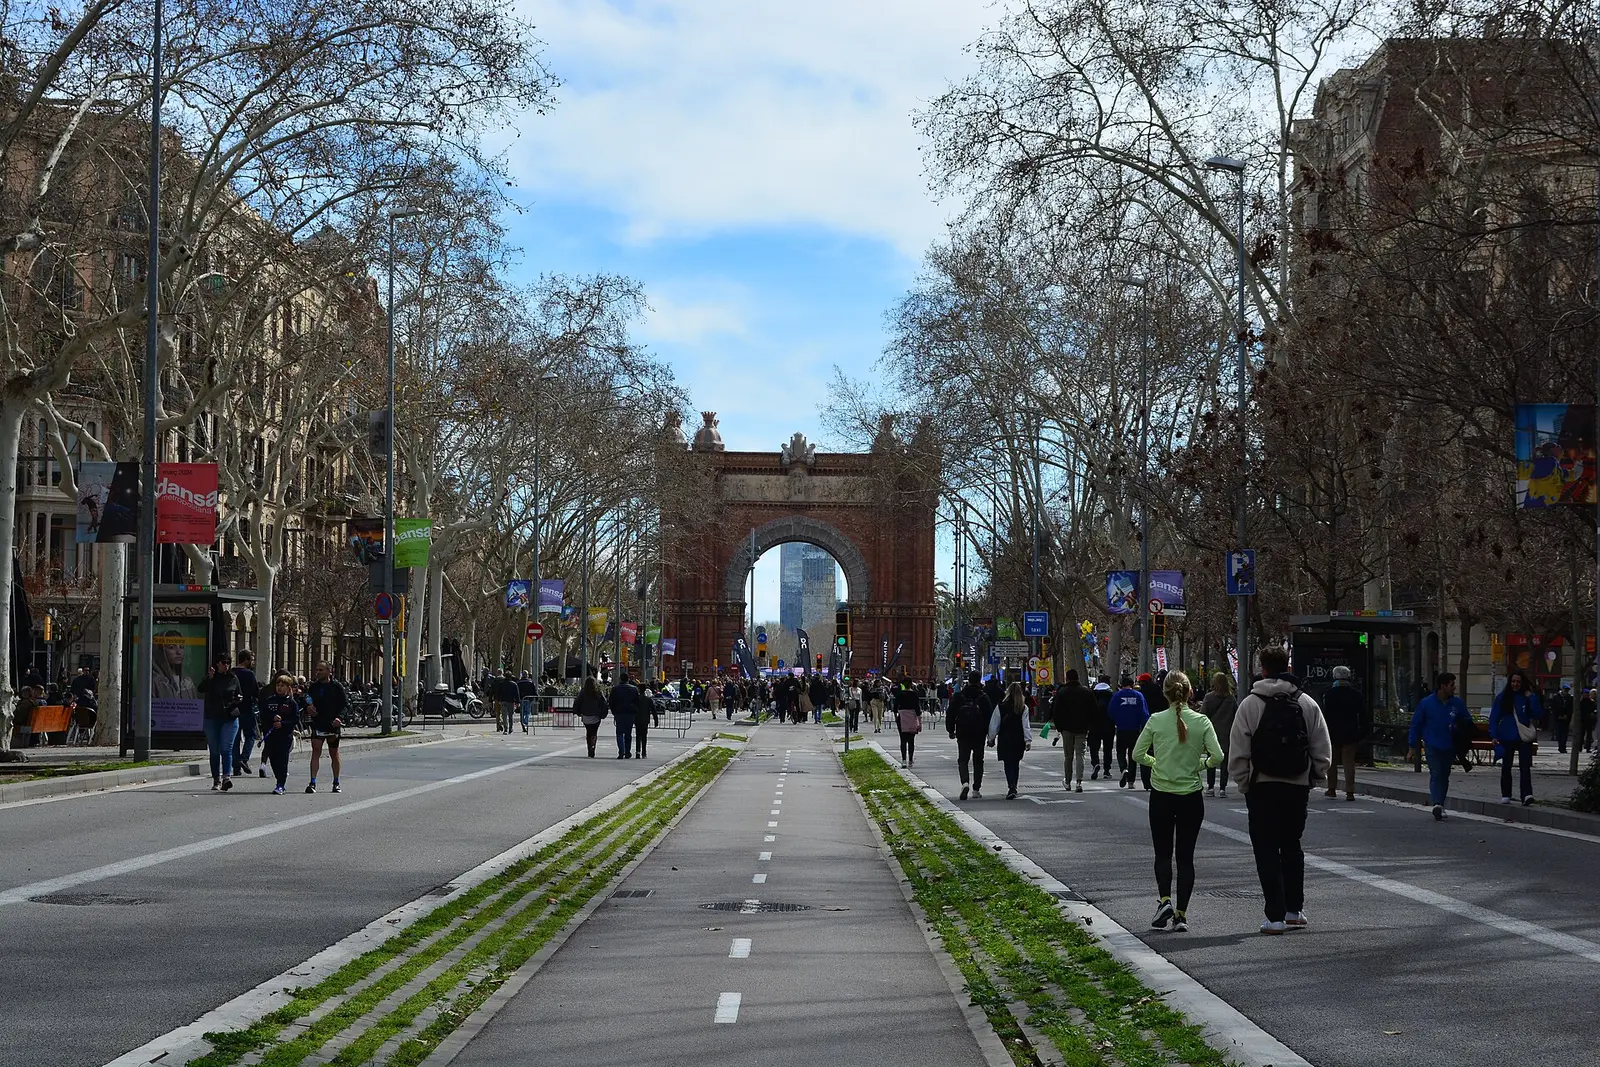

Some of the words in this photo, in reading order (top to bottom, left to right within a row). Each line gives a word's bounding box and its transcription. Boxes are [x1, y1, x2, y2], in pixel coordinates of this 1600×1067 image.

[156, 477, 218, 508] dansa
[539, 586, 564, 599] dansa
[1149, 580, 1184, 597] dansa
